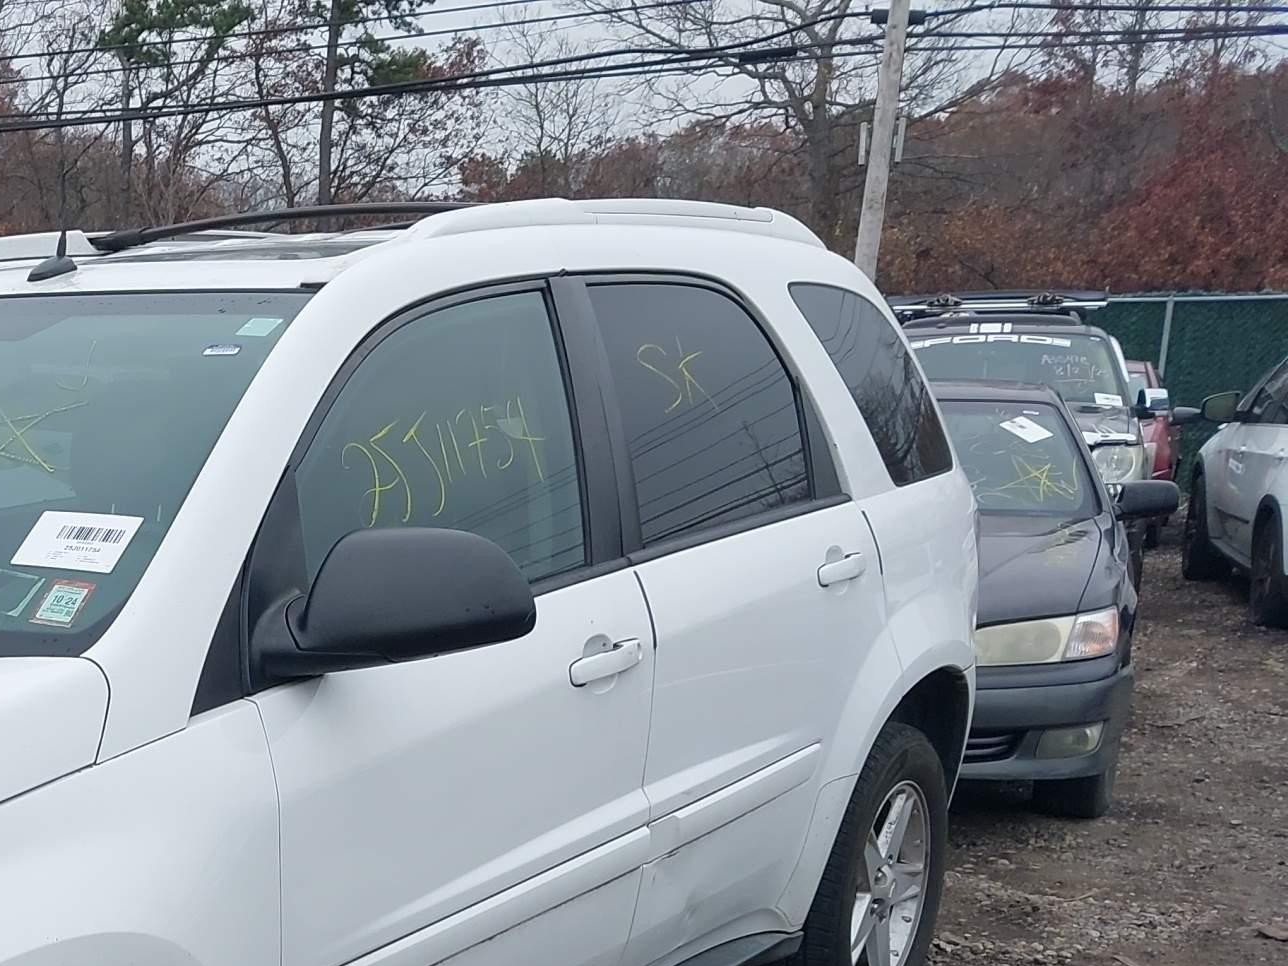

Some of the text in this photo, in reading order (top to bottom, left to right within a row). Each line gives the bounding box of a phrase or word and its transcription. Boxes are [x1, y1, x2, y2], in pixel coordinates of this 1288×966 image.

[924, 334, 1053, 347] FORD
[52, 594, 79, 606] 10 24
